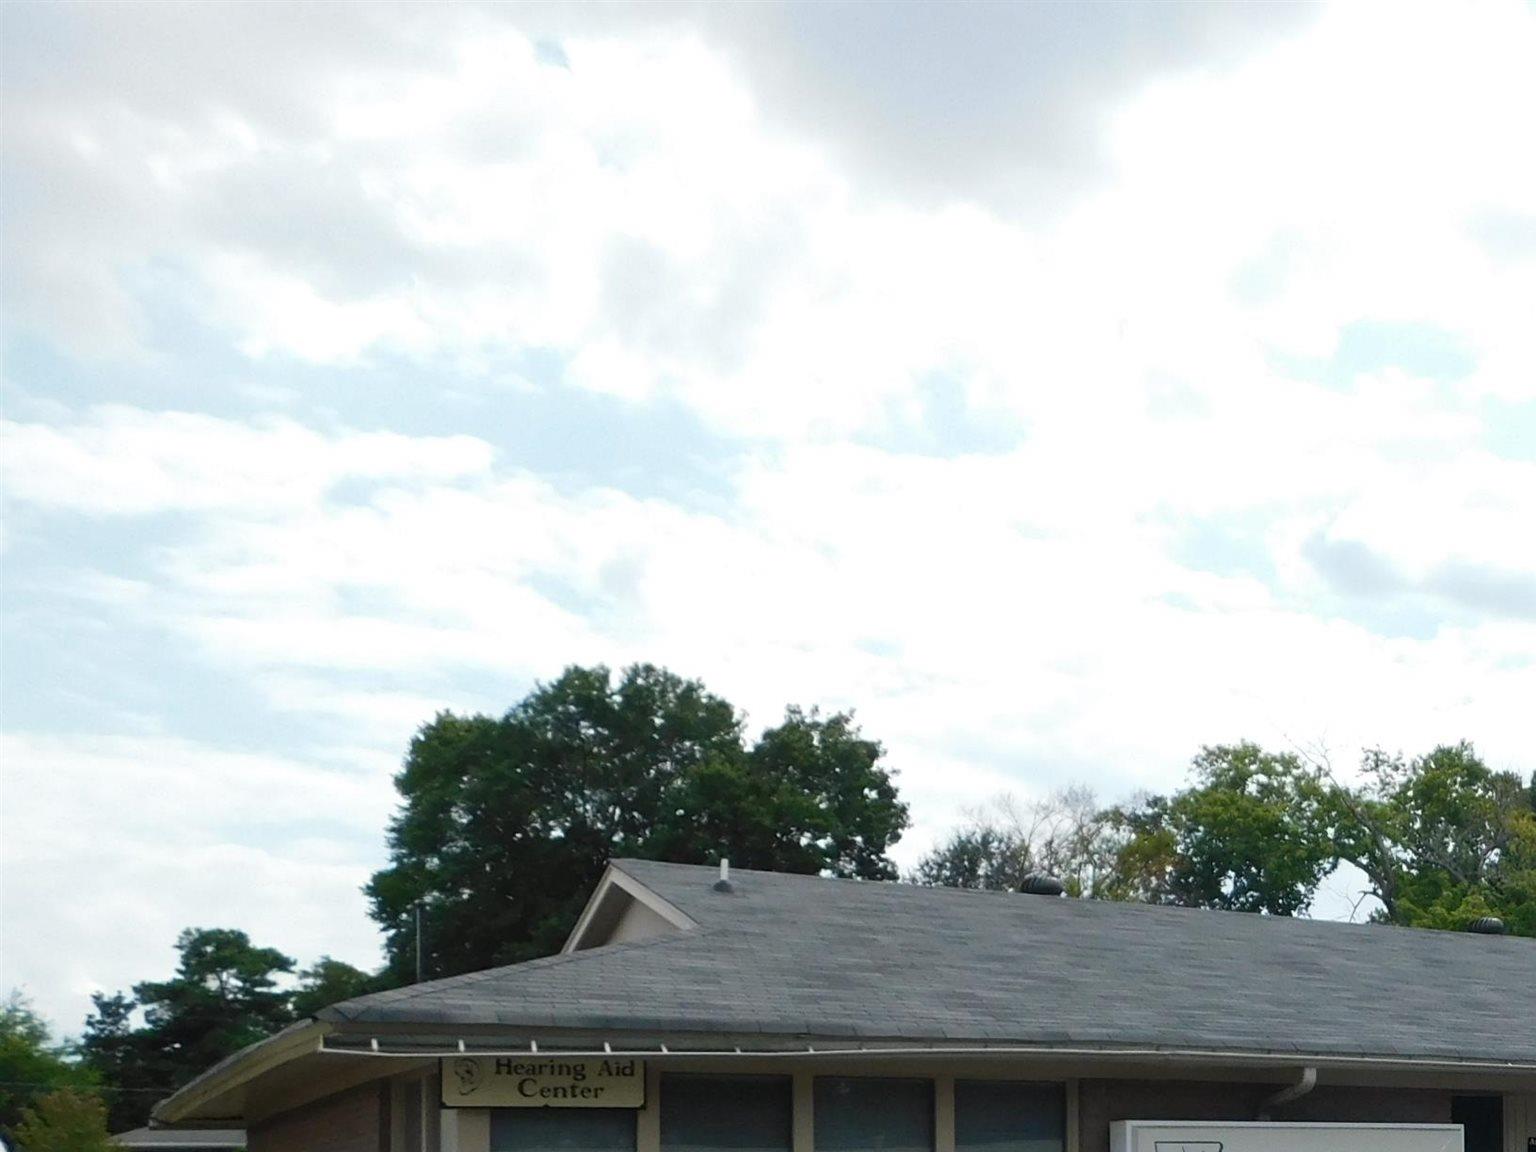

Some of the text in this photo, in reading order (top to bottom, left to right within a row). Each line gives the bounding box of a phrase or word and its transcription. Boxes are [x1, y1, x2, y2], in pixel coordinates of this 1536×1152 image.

[494, 1058, 635, 1081] Hearing Aid
[517, 1078, 605, 1099] Center
